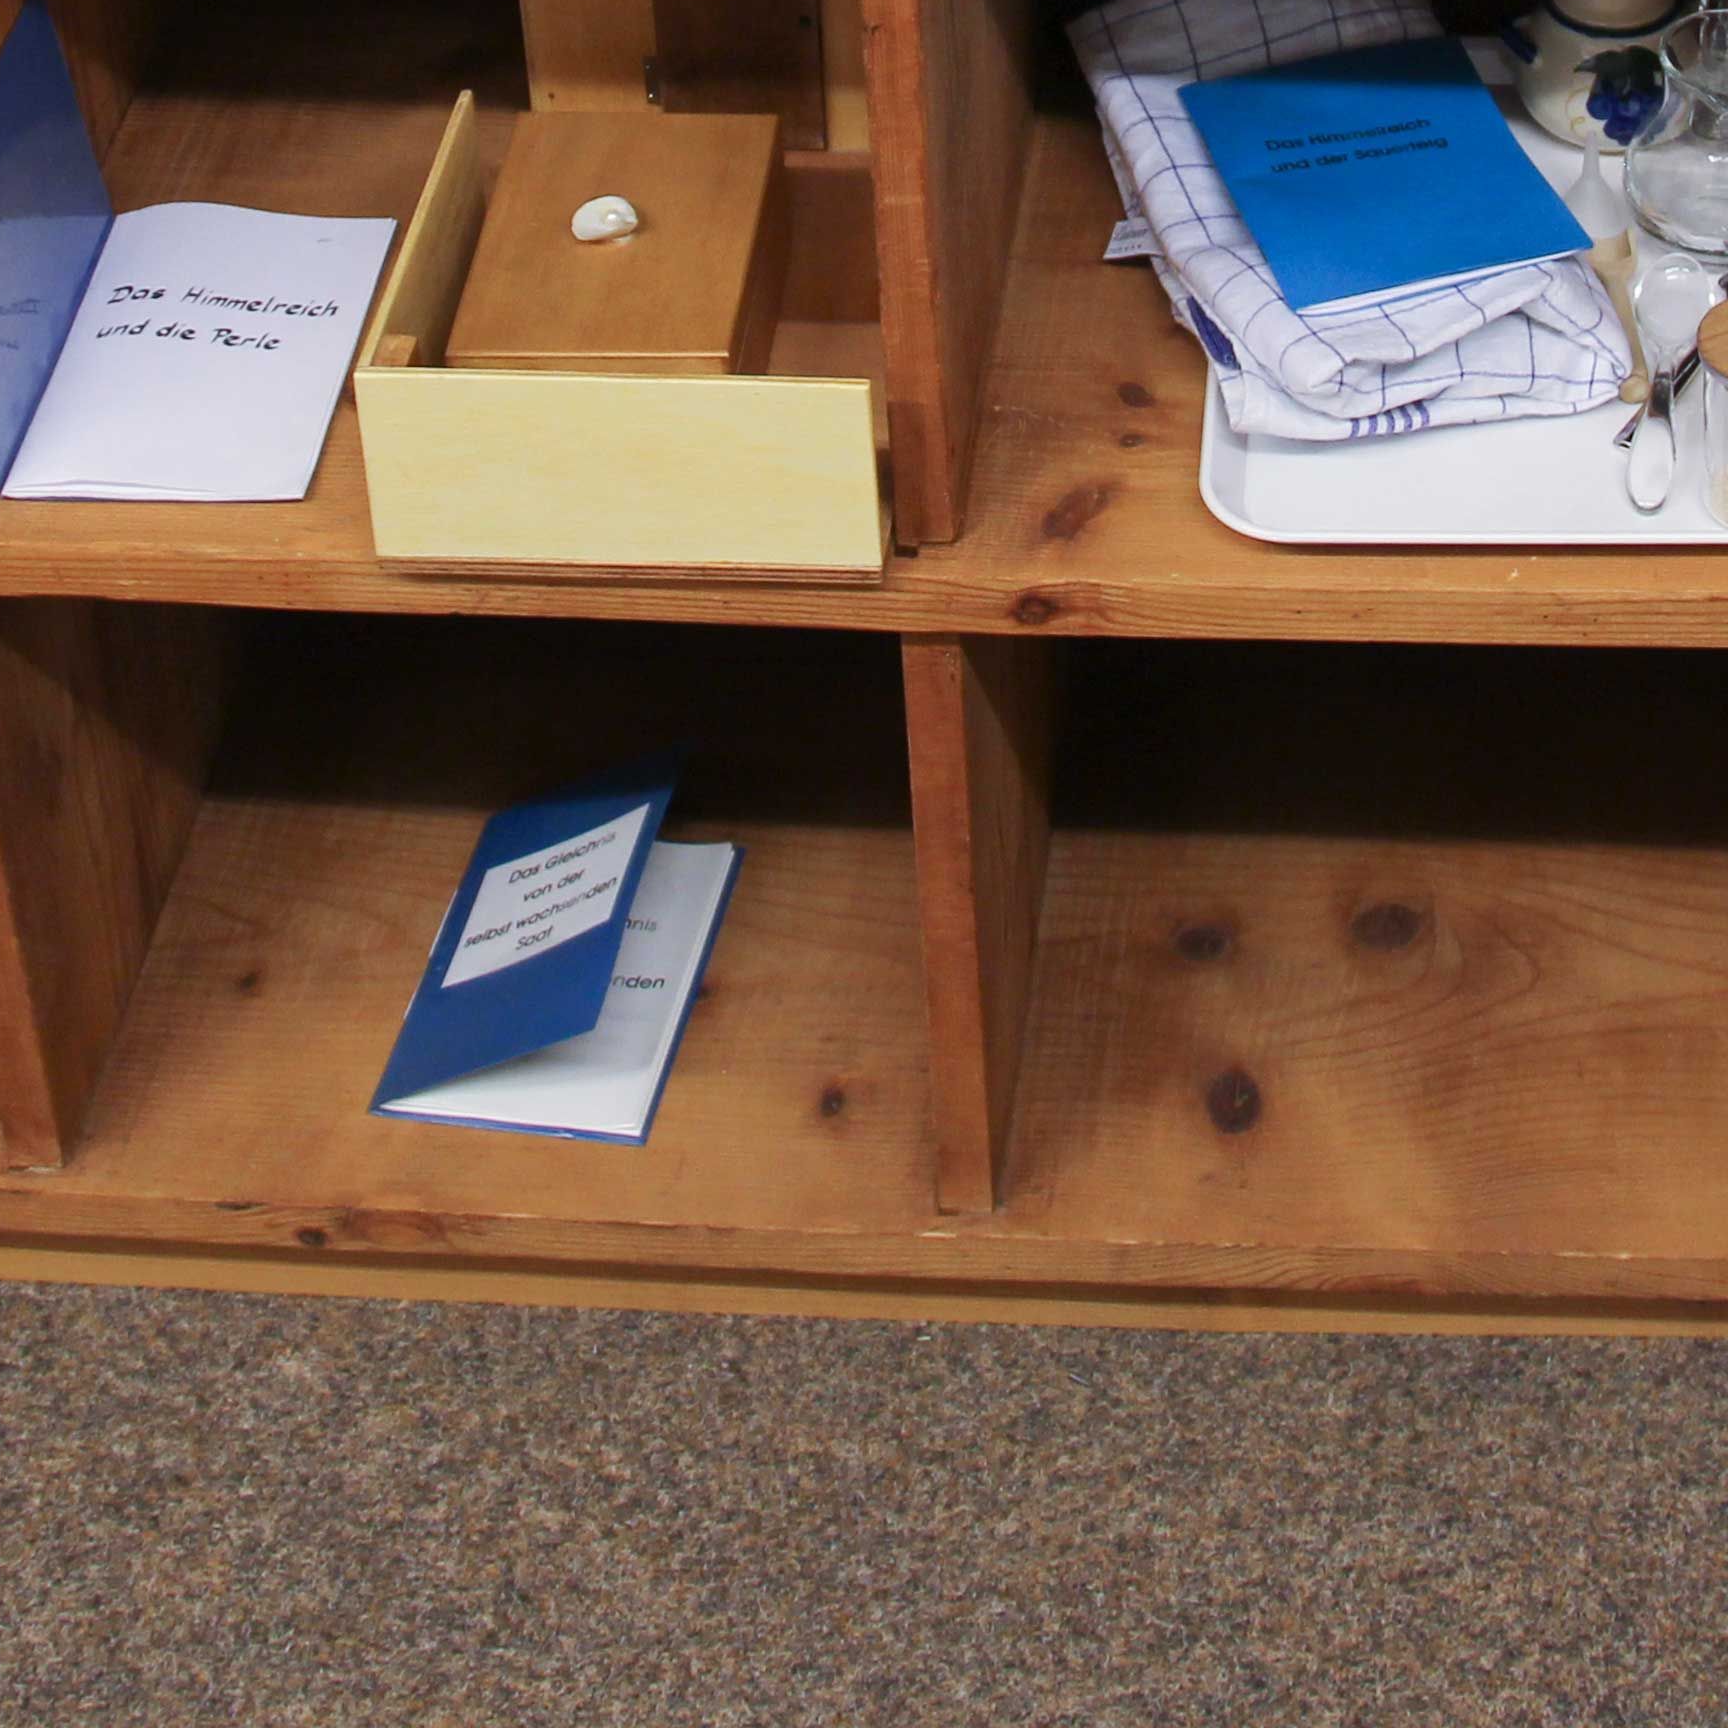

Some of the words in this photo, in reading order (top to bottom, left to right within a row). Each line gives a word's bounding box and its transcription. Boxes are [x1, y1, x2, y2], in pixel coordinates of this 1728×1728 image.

[1265, 138, 1304, 152] Das
[1308, 117, 1432, 146] Himmelreich
[1271, 158, 1311, 174] und
[1315, 153, 1349, 167] der
[1354, 136, 1449, 161] Sauerteig
[106, 284, 167, 305] Das
[179, 285, 340, 318] Himmelreich
[95, 318, 151, 340] und
[155, 321, 197, 341] die
[210, 327, 282, 351] Perle
[507, 863, 541, 885] Das
[543, 831, 617, 867] Gleichnis
[522, 883, 553, 903] von
[556, 869, 585, 891] der
[463, 920, 513, 949] selbst
[515, 875, 618, 930] wachsenden
[514, 925, 555, 951] Saat
